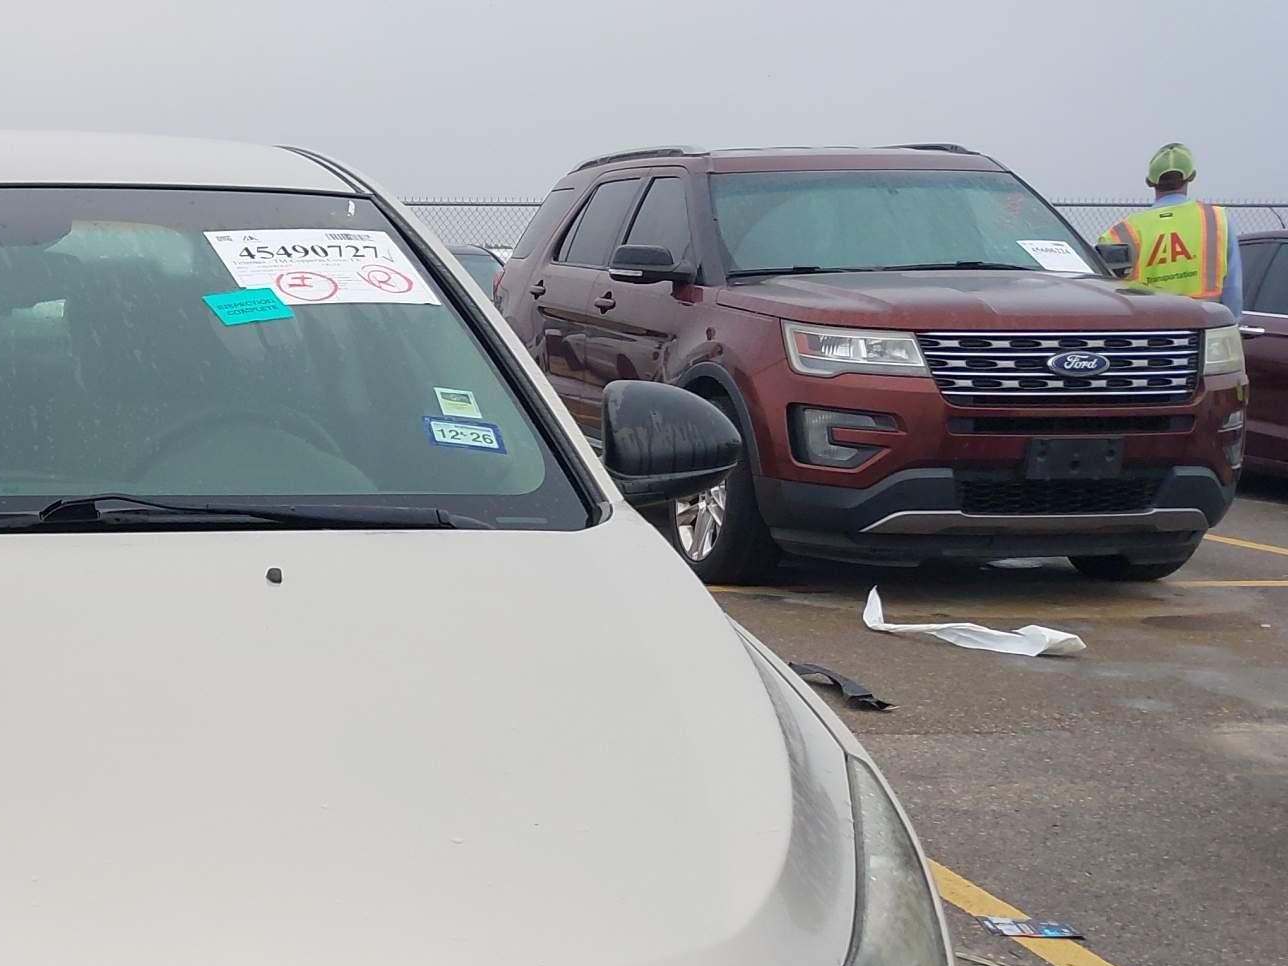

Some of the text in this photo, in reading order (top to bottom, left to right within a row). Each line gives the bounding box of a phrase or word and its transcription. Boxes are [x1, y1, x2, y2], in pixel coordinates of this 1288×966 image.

[238, 243, 378, 260] 45490727
[1146, 270, 1199, 284] Transportation
[216, 298, 276, 310] INSPECTION
[227, 304, 279, 316] COMPLETE
[1063, 354, 1099, 369] Ford
